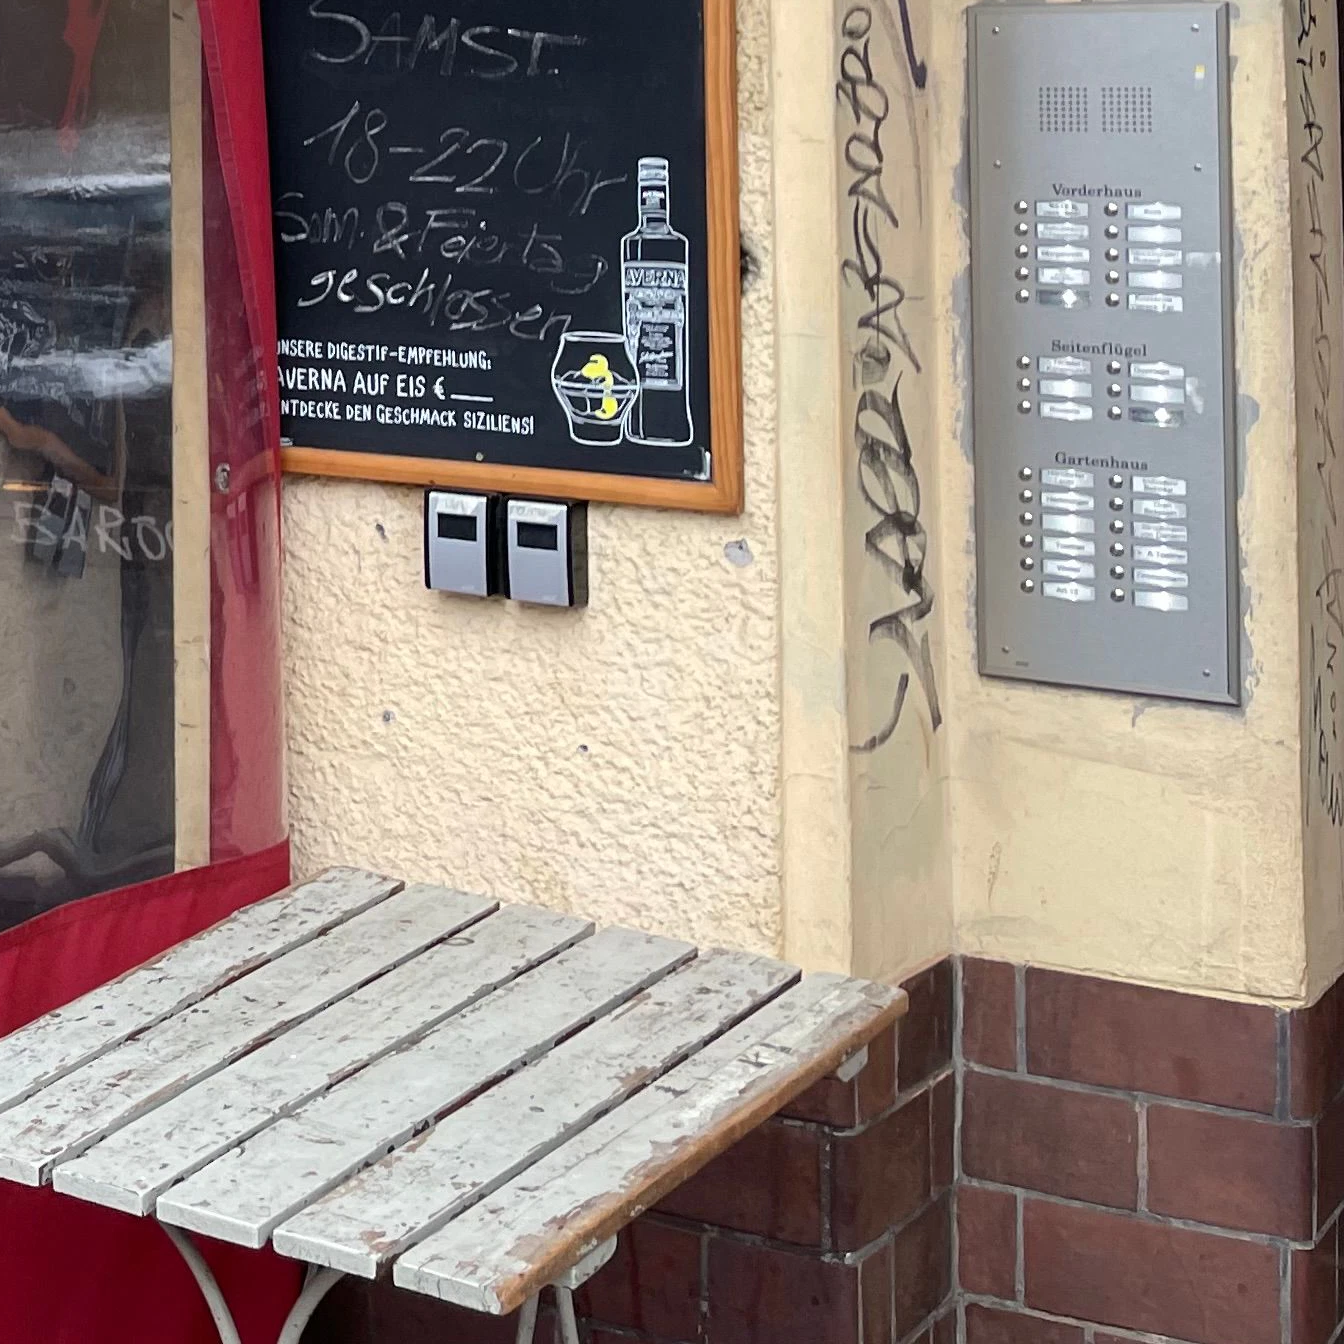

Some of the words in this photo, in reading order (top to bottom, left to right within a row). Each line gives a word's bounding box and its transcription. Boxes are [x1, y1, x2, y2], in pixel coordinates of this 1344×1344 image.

[303, 100, 510, 194] 18-22
[513, 130, 628, 216] Uhr
[1052, 183, 1142, 198] Vorderhaus
[373, 201, 410, 258] &
[297, 266, 572, 342] geschlossen
[1050, 339, 1148, 359] Seitenflügel
[352, 370, 390, 396] AUF
[396, 373, 426, 399] EIS
[278, 399, 342, 421] NTDECKE
[346, 404, 372, 422] DEN
[376, 404, 457, 427] GESCHMACK
[1054, 450, 1149, 471] Gartenhaus
